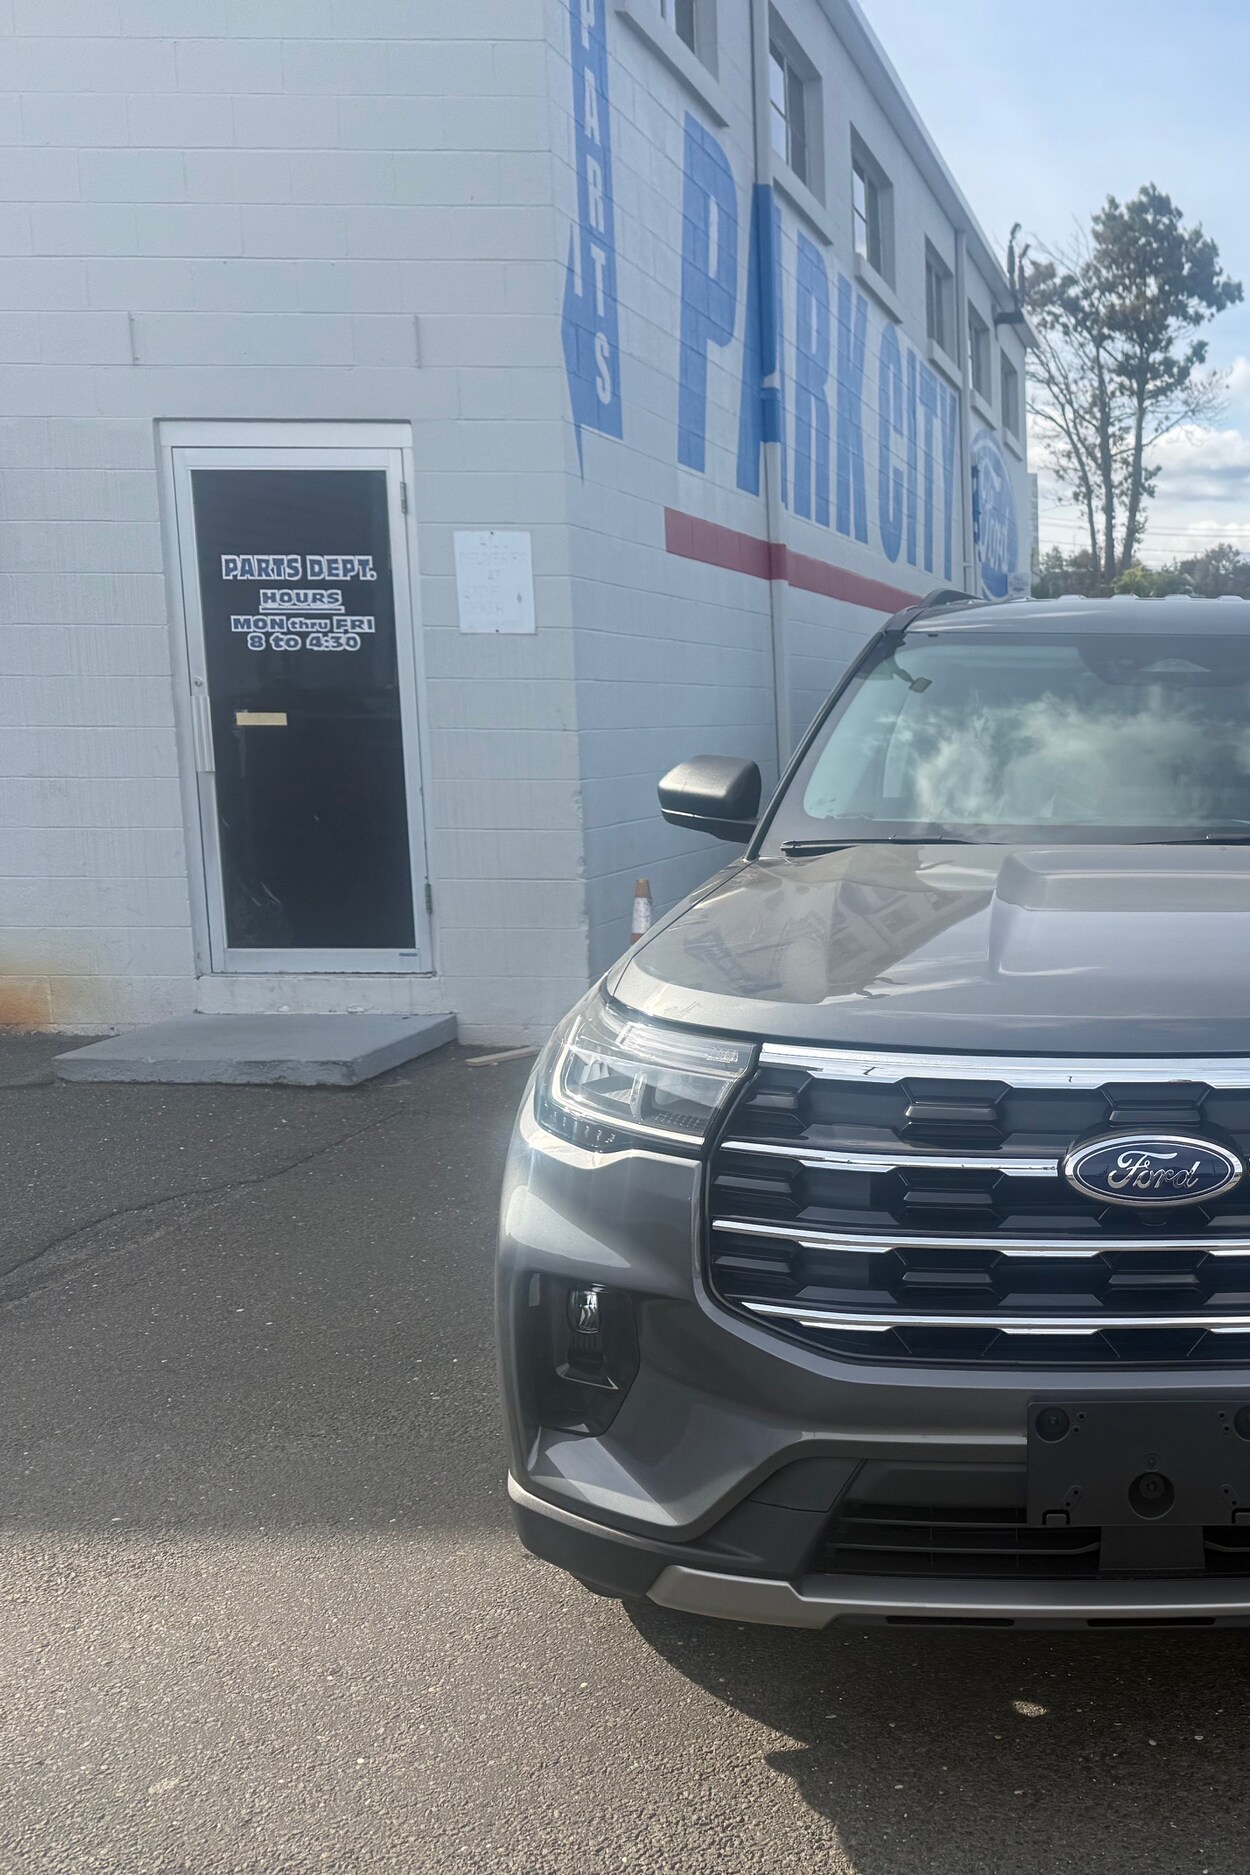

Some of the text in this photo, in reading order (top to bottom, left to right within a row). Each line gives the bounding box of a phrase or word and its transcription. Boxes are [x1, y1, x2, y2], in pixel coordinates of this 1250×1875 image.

[580, 0, 612, 405] PARTS
[677, 111, 958, 582] PARK CITY
[974, 458, 1010, 575] Ford
[221, 555, 377, 580] PARTS DEPT.
[260, 589, 342, 606] HOURS
[231, 615, 375, 632] MON thru FRI
[247, 633, 361, 650] 8 to 4:30
[1107, 1150, 1201, 1189] Ford
